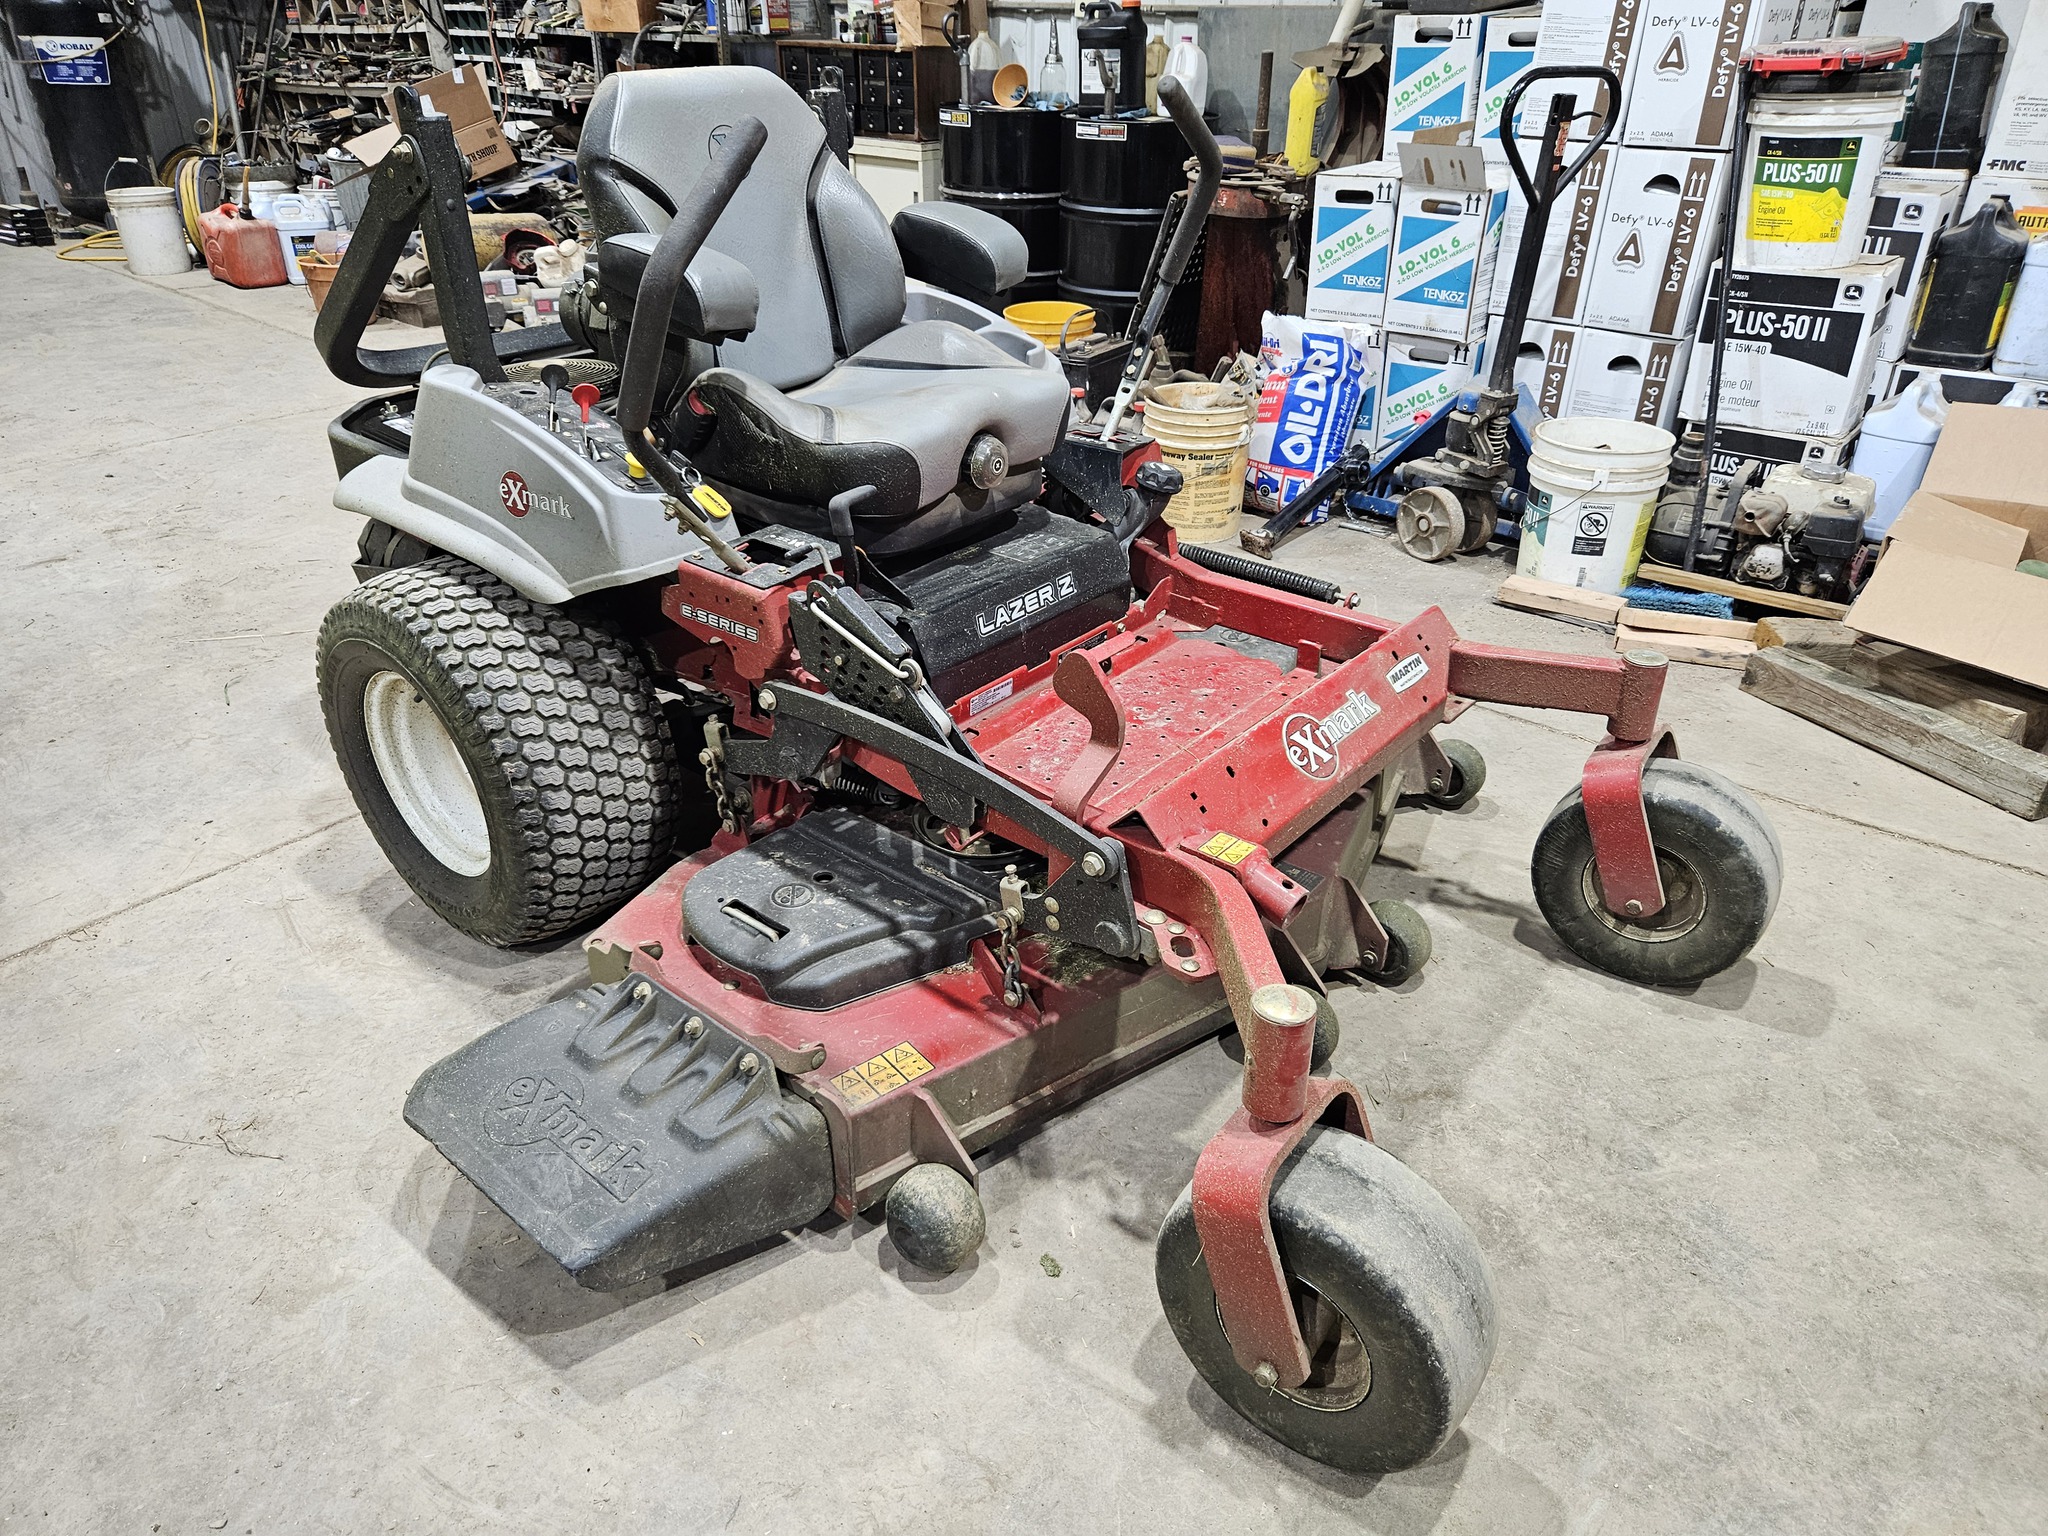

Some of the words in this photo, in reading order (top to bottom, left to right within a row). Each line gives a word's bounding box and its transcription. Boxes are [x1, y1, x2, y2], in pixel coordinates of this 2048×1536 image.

[1691, 16, 1720, 28] LV-6
[1723, 3, 1744, 43] LV-6
[1394, 71, 1440, 107] LO-VOL
[1443, 62, 1453, 74] 6
[1407, 97, 1418, 108] LOW
[1419, 83, 1441, 99] VOLATILE
[1441, 65, 1467, 84] HERBICIDE
[476, 144, 498, 160] SHOUP
[1987, 159, 2027, 172] FMC
[1763, 162, 1828, 184] PLUS-50
[1575, 196, 1594, 232] LV-6
[1647, 216, 1674, 229] LV-6
[1758, 205, 1776, 215] Engine
[1777, 206, 1786, 215] Oil
[1677, 207, 1698, 244] LV-6
[1316, 231, 1363, 265] LO-VOL
[1366, 224, 1375, 236] 6
[1330, 256, 1342, 267] LOW
[1342, 243, 1365, 258] VOLATILE
[1364, 228, 1390, 245] HERBICIDE
[1399, 244, 1448, 276] LO-VOL
[1452, 236, 1461, 249] 6
[1411, 267, 1424, 278] LOW
[1425, 256, 1448, 271] VOLATILE
[1449, 241, 1476, 258] HERBICIDE
[1396, 322, 1416, 330] CONTENTS
[1609, 315, 1630, 323] ADAMA
[1735, 343, 1767, 356] 15W-40
[1545, 372, 1562, 404] LV-6
[1740, 379, 1753, 391] Oil
[1387, 390, 1435, 417] LO-VOL
[1438, 383, 1448, 395] 6
[1641, 386, 1660, 419] LV-6
[1728, 396, 1761, 408] moteur
[1400, 410, 1411, 420] LOW
[1188, 452, 1214, 461] Sealer
[1258, 463, 1272, 471] MANY
[1272, 466, 1285, 474] USES
[977, 582, 1058, 637] LAZER
[1056, 572, 1077, 601] Z
[681, 603, 759, 643] E-SERIES
[1390, 656, 1423, 685] MARTIN
